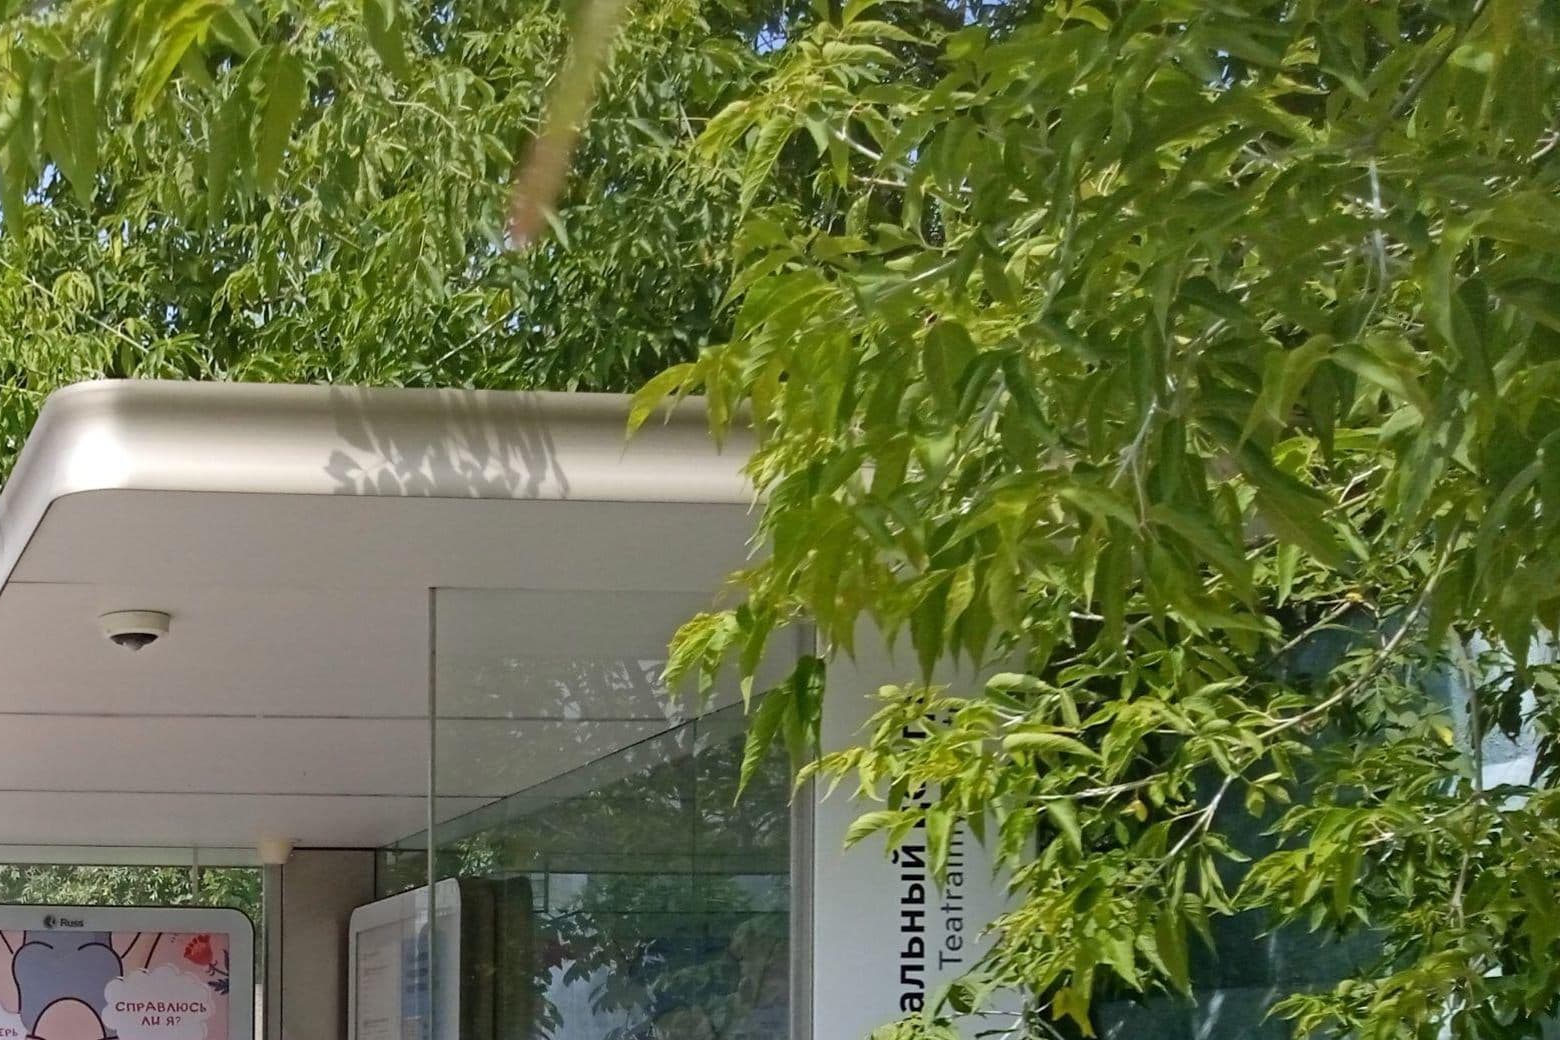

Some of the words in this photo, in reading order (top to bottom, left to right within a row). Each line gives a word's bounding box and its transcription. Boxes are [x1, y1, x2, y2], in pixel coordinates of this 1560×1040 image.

[59, 918, 84, 928] Russ
[115, 1001, 207, 1014] СПРАВЛЮСЬ
[141, 1016, 161, 1027] ЛИ
[166, 1016, 181, 1027] Я?
